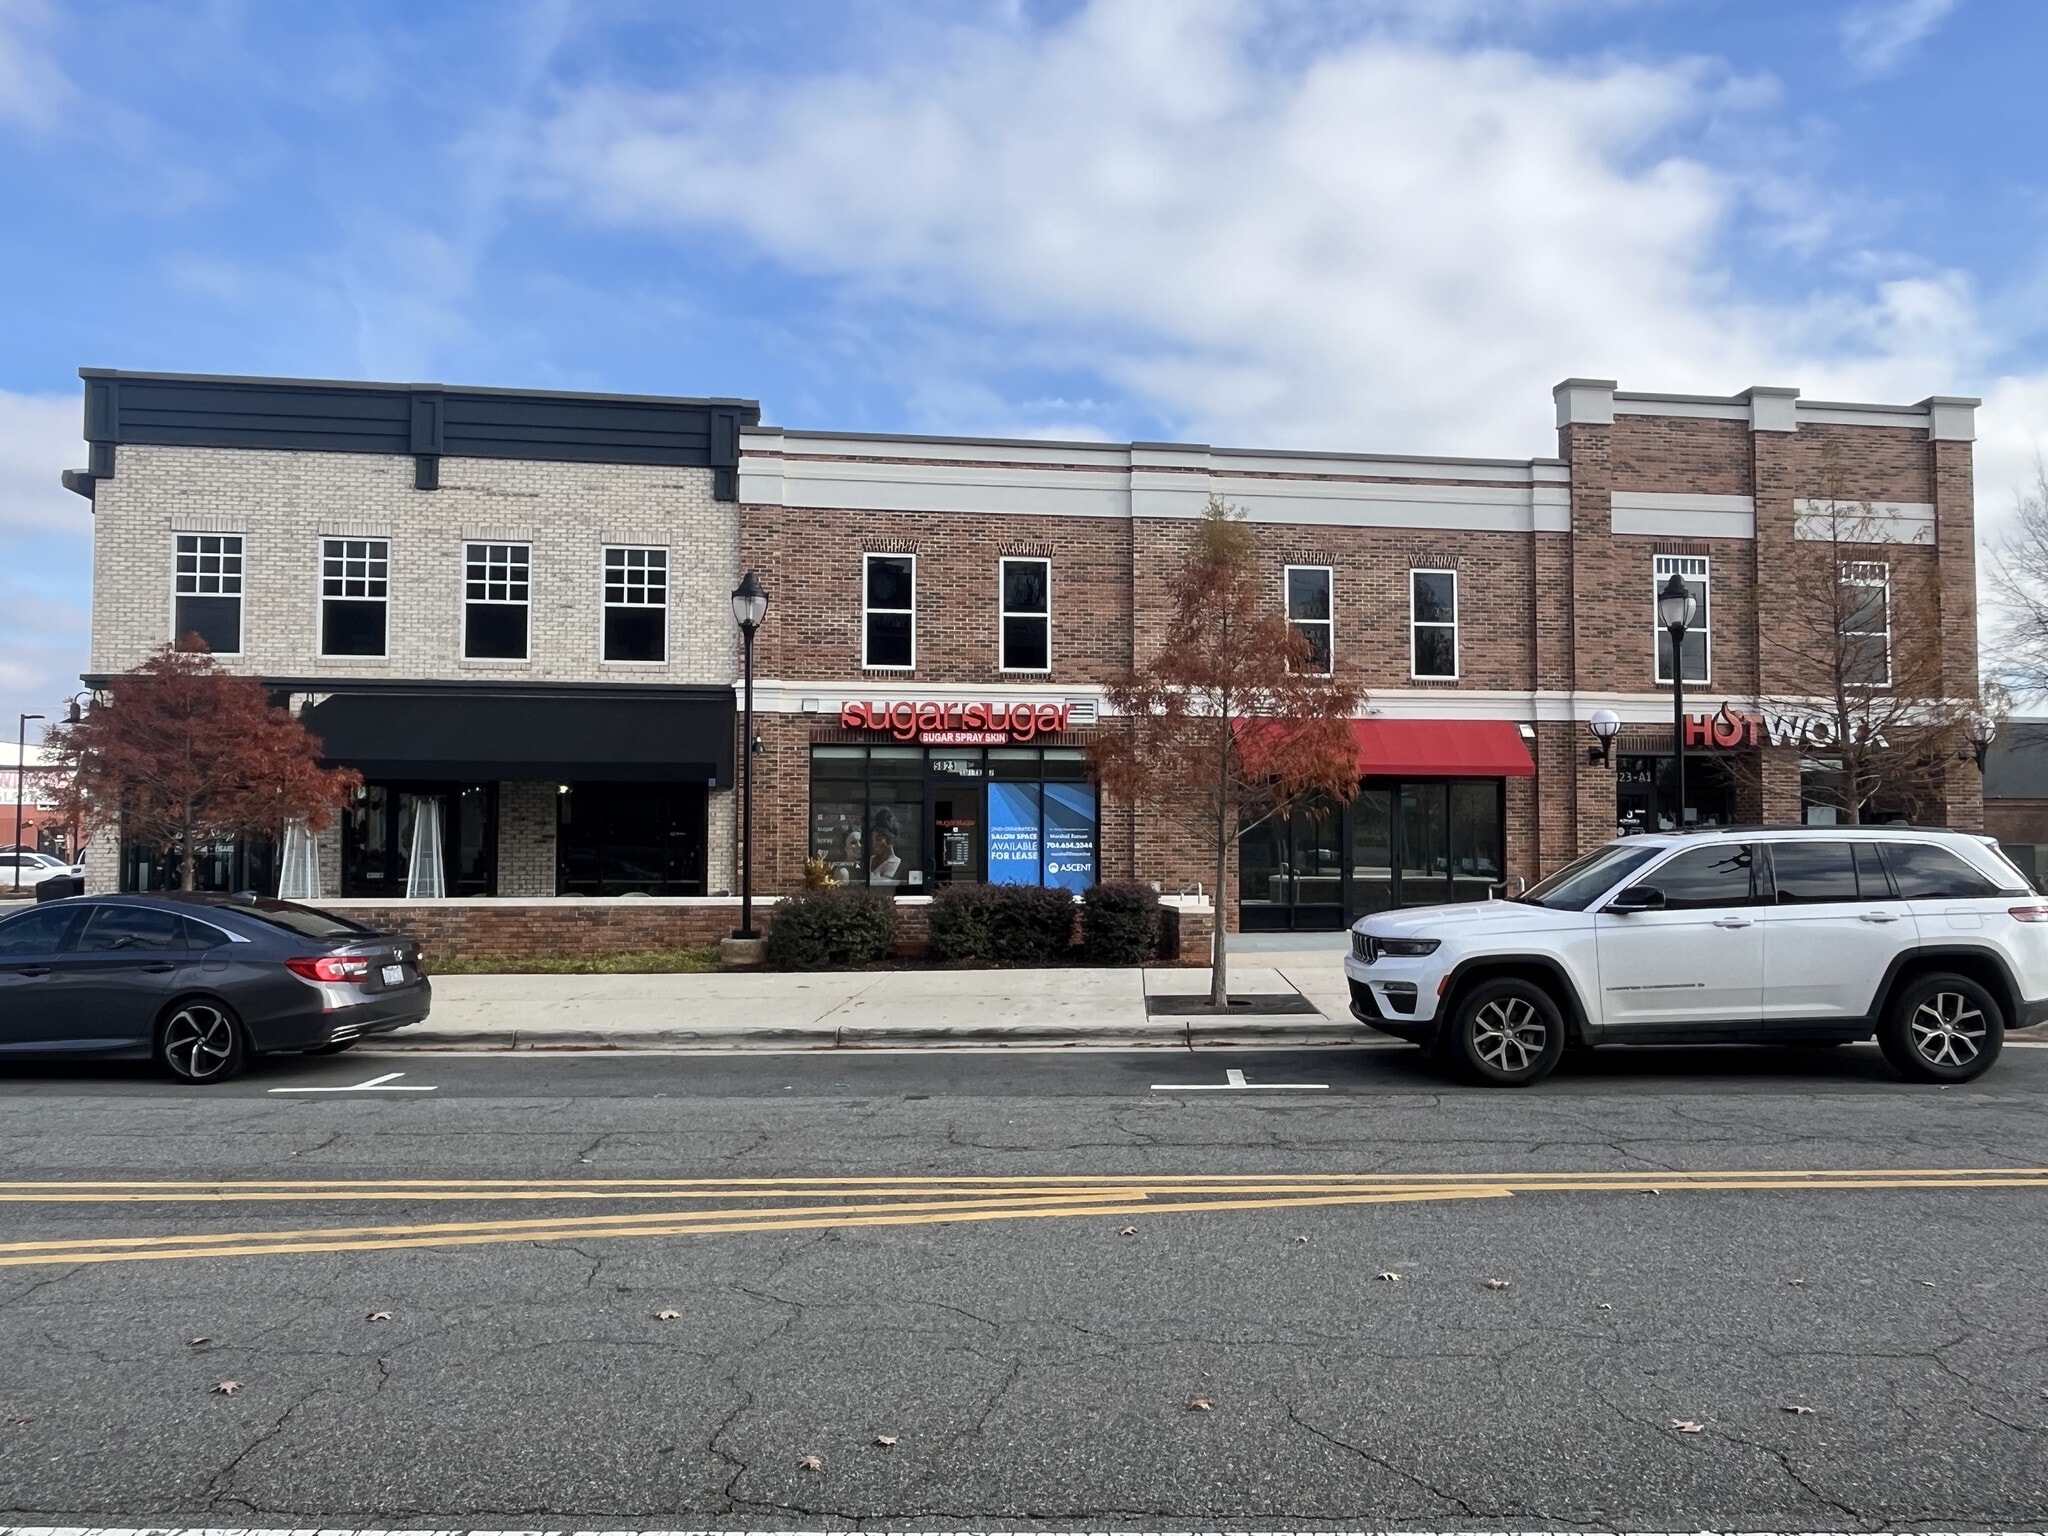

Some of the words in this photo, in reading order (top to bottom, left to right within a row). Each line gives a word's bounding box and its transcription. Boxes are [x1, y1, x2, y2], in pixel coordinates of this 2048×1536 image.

[922, 732, 954, 743] SUGAR
[955, 732, 984, 743] SPRAY
[985, 732, 1006, 743] SKIN
[991, 841, 1037, 851] AVAILABLE
[991, 851, 1009, 860] FOR
[1012, 851, 1038, 860] LEASE
[1060, 863, 1092, 872] ASCENT
